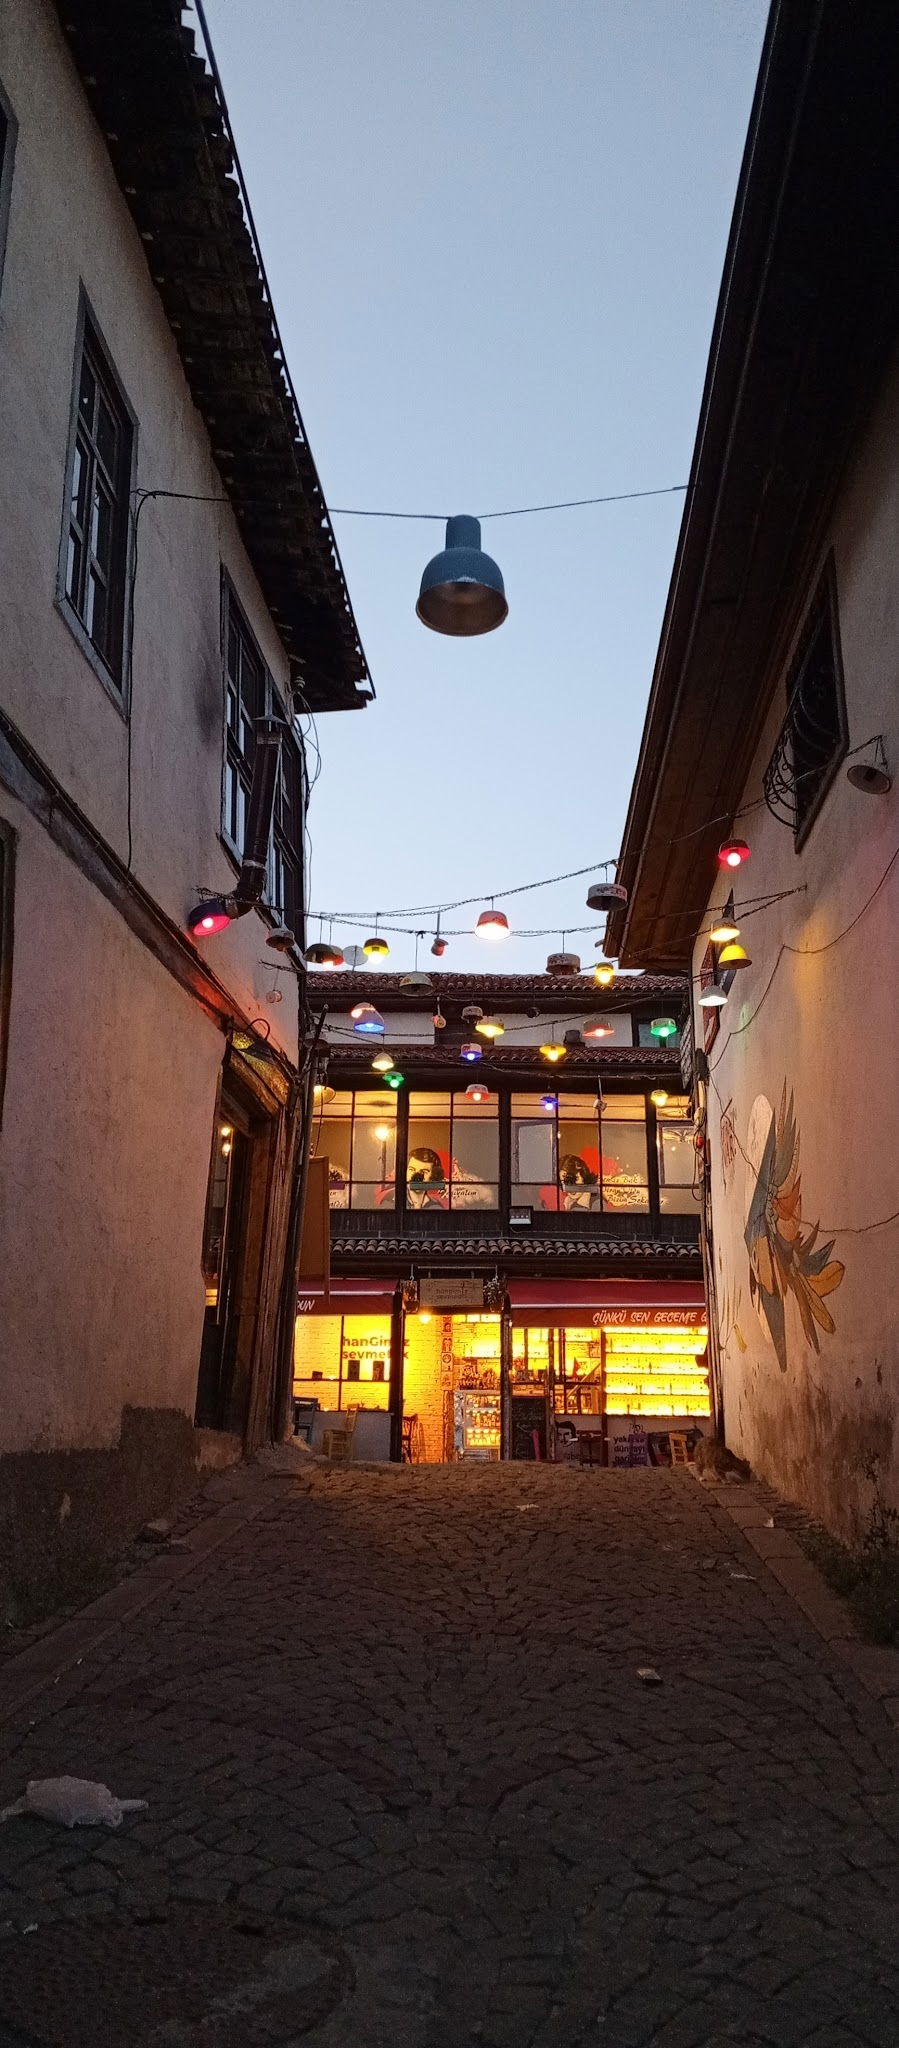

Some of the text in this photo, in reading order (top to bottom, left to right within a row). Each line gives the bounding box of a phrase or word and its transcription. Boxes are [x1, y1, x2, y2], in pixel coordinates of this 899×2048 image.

[592, 1310, 627, 1326] ÇÜNKÜ
[630, 1311, 651, 1324] SEN
[654, 1311, 698, 1324] GECEME
